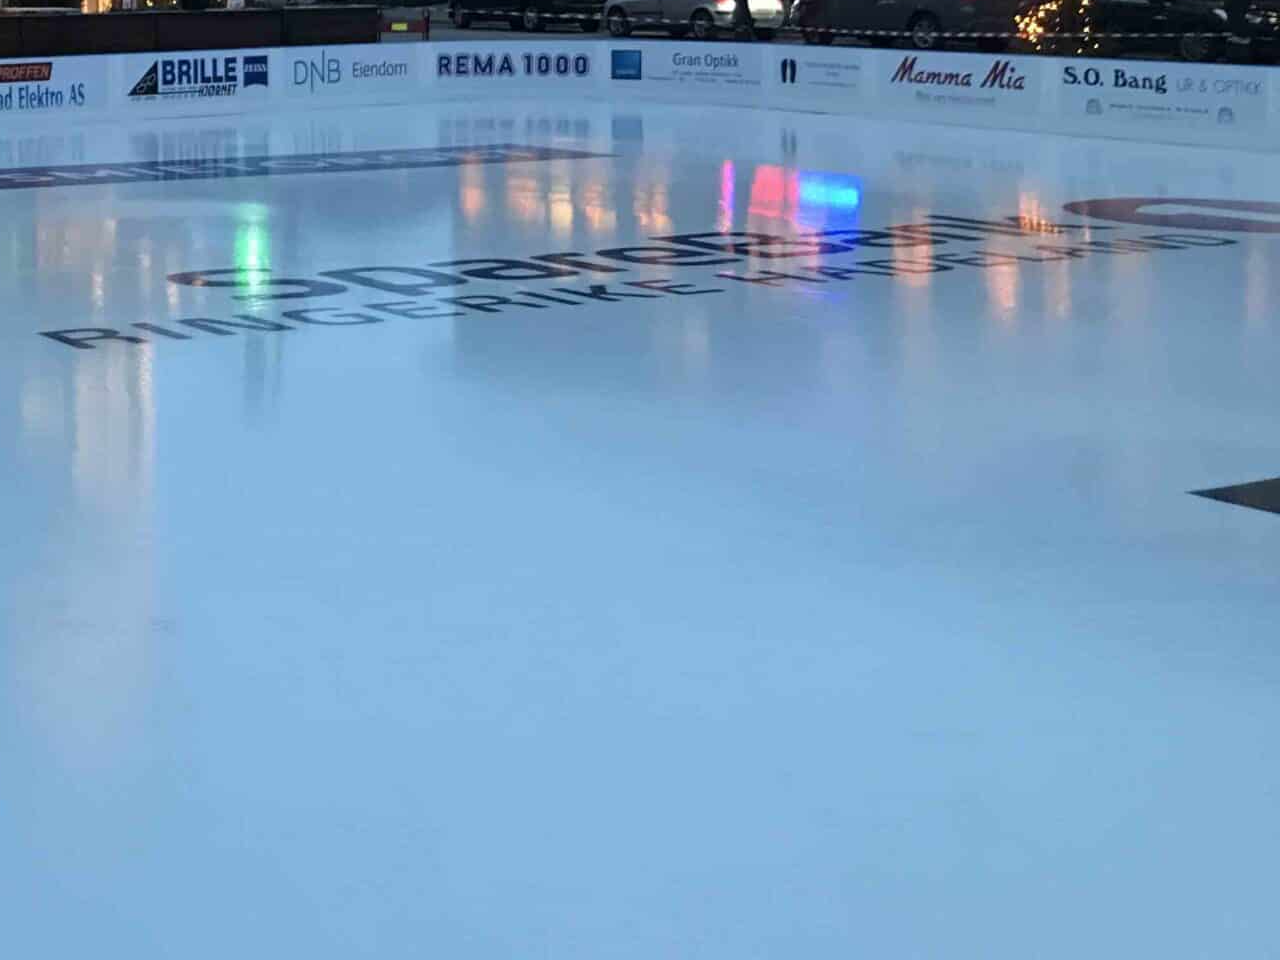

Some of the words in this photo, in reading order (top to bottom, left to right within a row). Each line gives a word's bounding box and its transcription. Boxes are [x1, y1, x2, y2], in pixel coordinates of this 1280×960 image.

[161, 56, 238, 86] BRILLE
[294, 50, 342, 93] DNB
[352, 60, 408, 78] Eiendom
[437, 53, 515, 77] REMA
[523, 53, 589, 76] 1000
[673, 52, 701, 67] Gran
[705, 54, 739, 69] Optikk
[891, 56, 972, 87] Mamma
[980, 60, 1025, 90] Mia
[1063, 66, 1104, 87] S.O.
[1113, 68, 1168, 94] Bang
[18, 84, 64, 109] Elektro
[69, 83, 86, 106] AS
[38, 279, 727, 349] RINGERIKE
